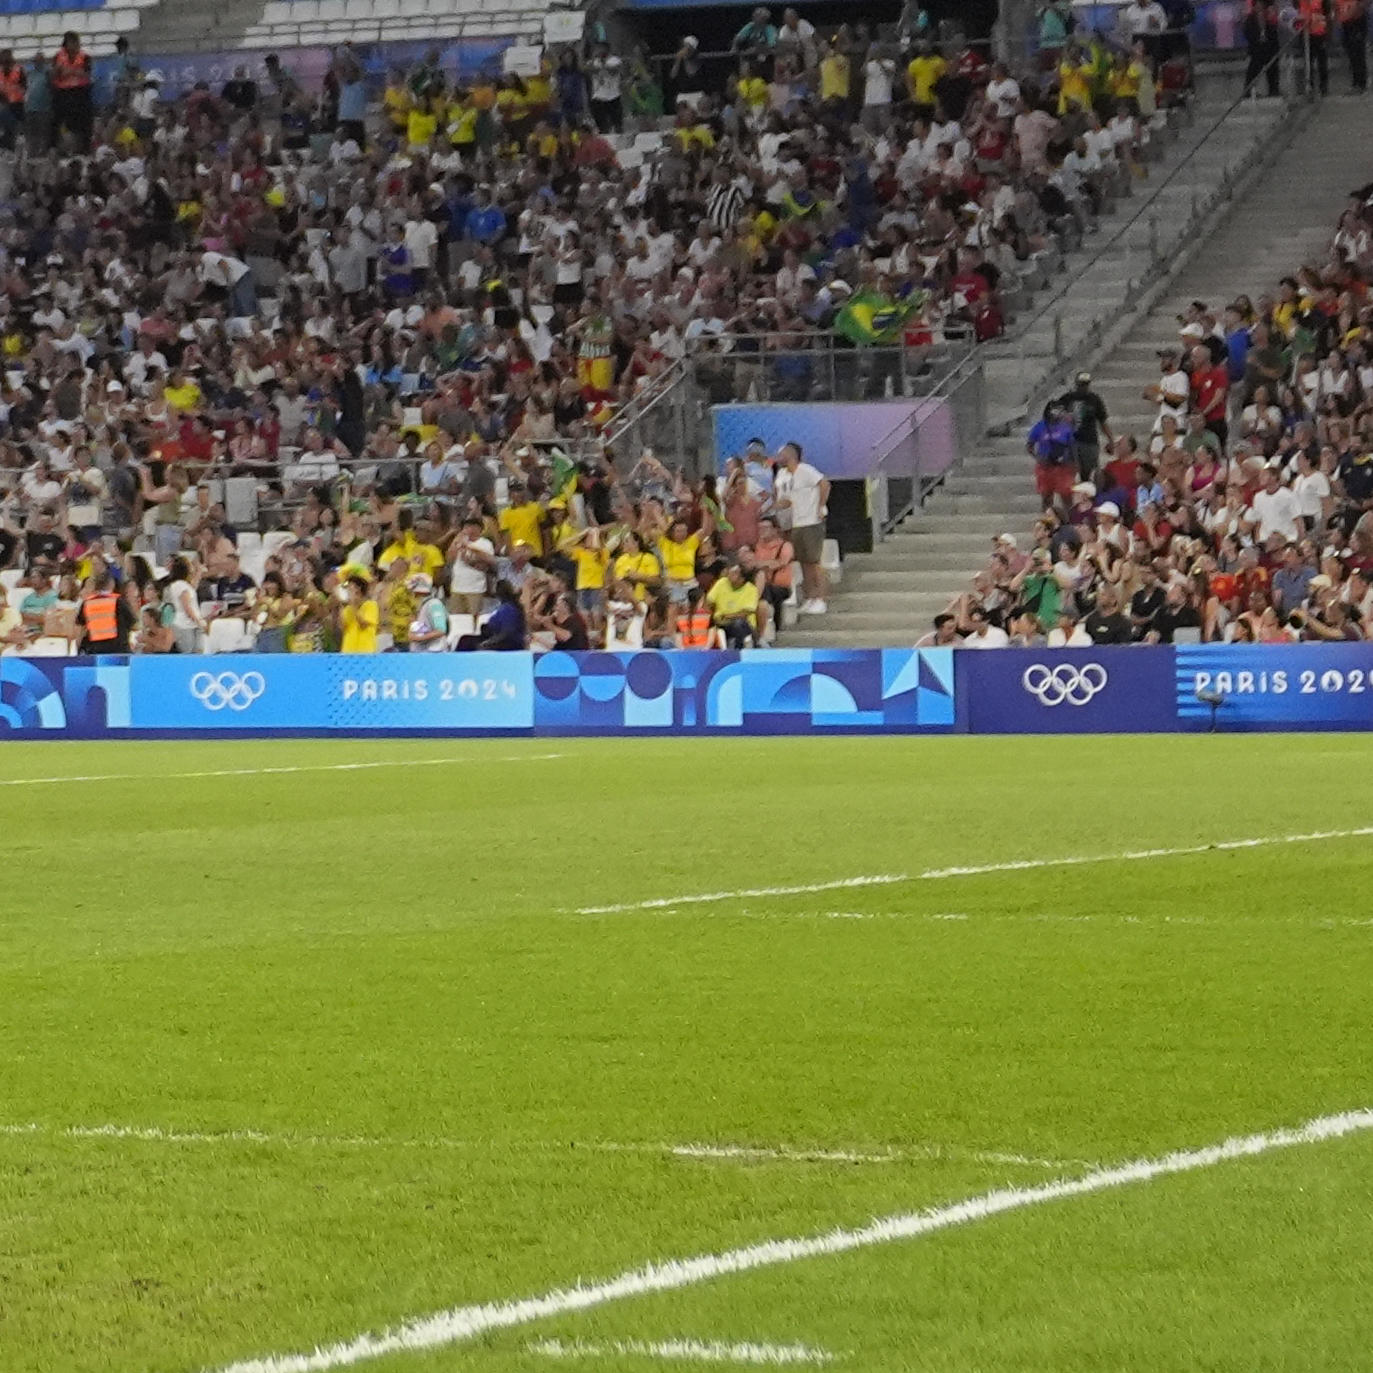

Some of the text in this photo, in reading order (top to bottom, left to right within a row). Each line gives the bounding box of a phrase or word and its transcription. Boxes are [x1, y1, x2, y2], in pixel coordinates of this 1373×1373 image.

[342, 678, 517, 702] PARIS 2024
[1193, 669, 1373, 694] PARIS 202
